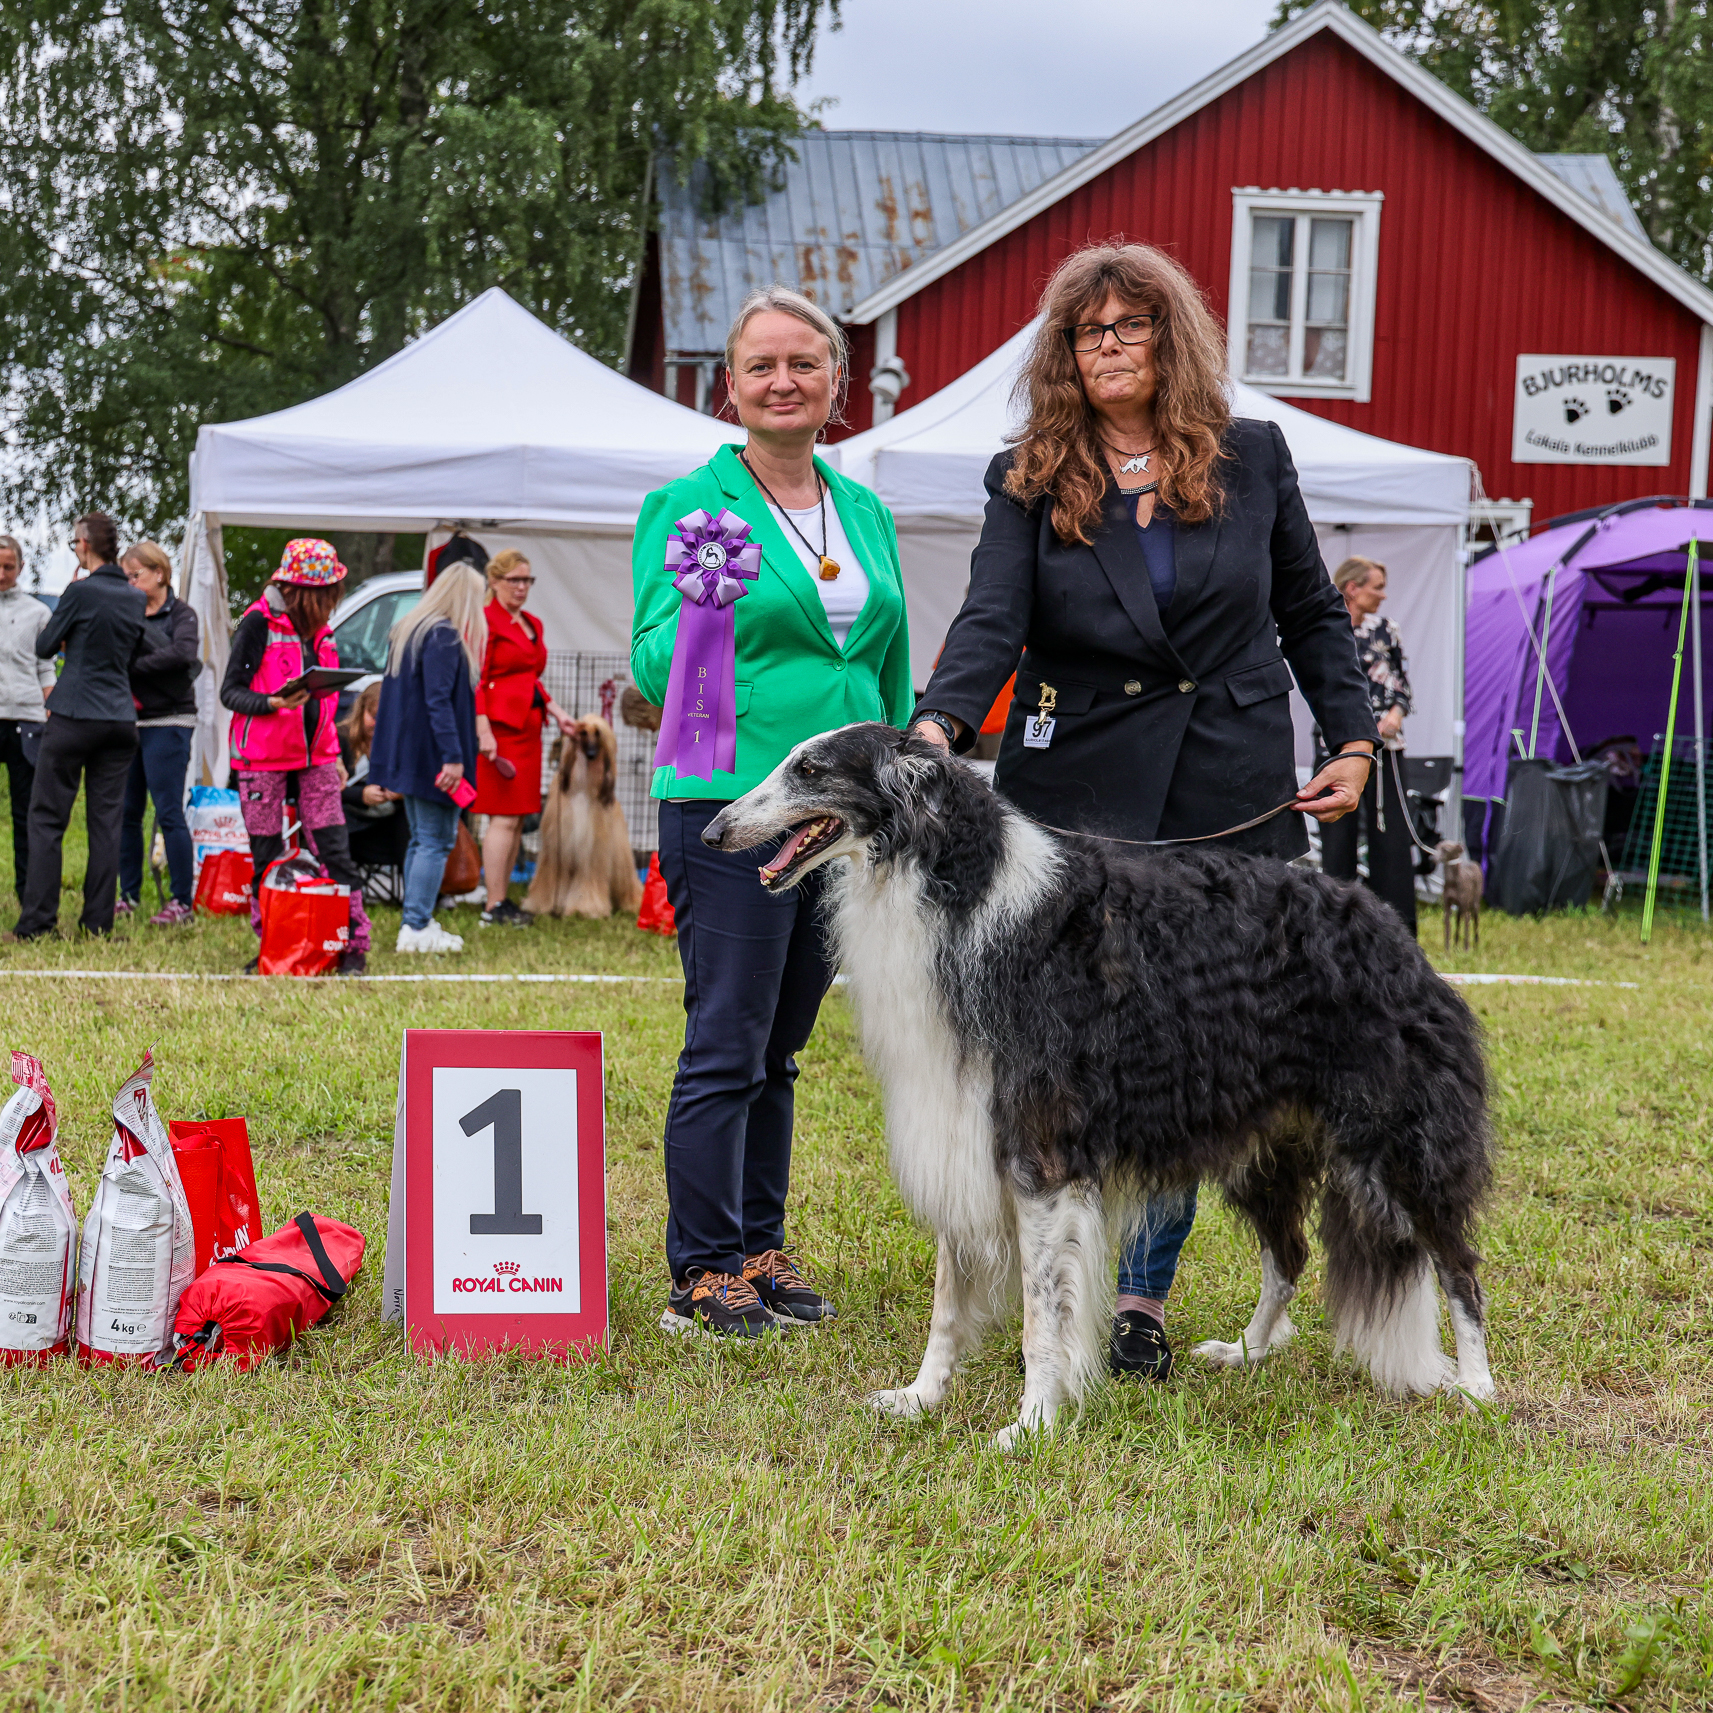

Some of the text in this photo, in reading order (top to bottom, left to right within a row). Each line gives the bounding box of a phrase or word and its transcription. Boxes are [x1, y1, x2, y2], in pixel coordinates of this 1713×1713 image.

[1522, 363, 1668, 399] BJURHOLMS
[693, 729, 701, 744] 1
[1032, 720, 1052, 738] 97
[458, 1088, 543, 1235] 1
[452, 1277, 563, 1293] ROYAL CANIN
[110, 1318, 135, 1334] 4 kg
